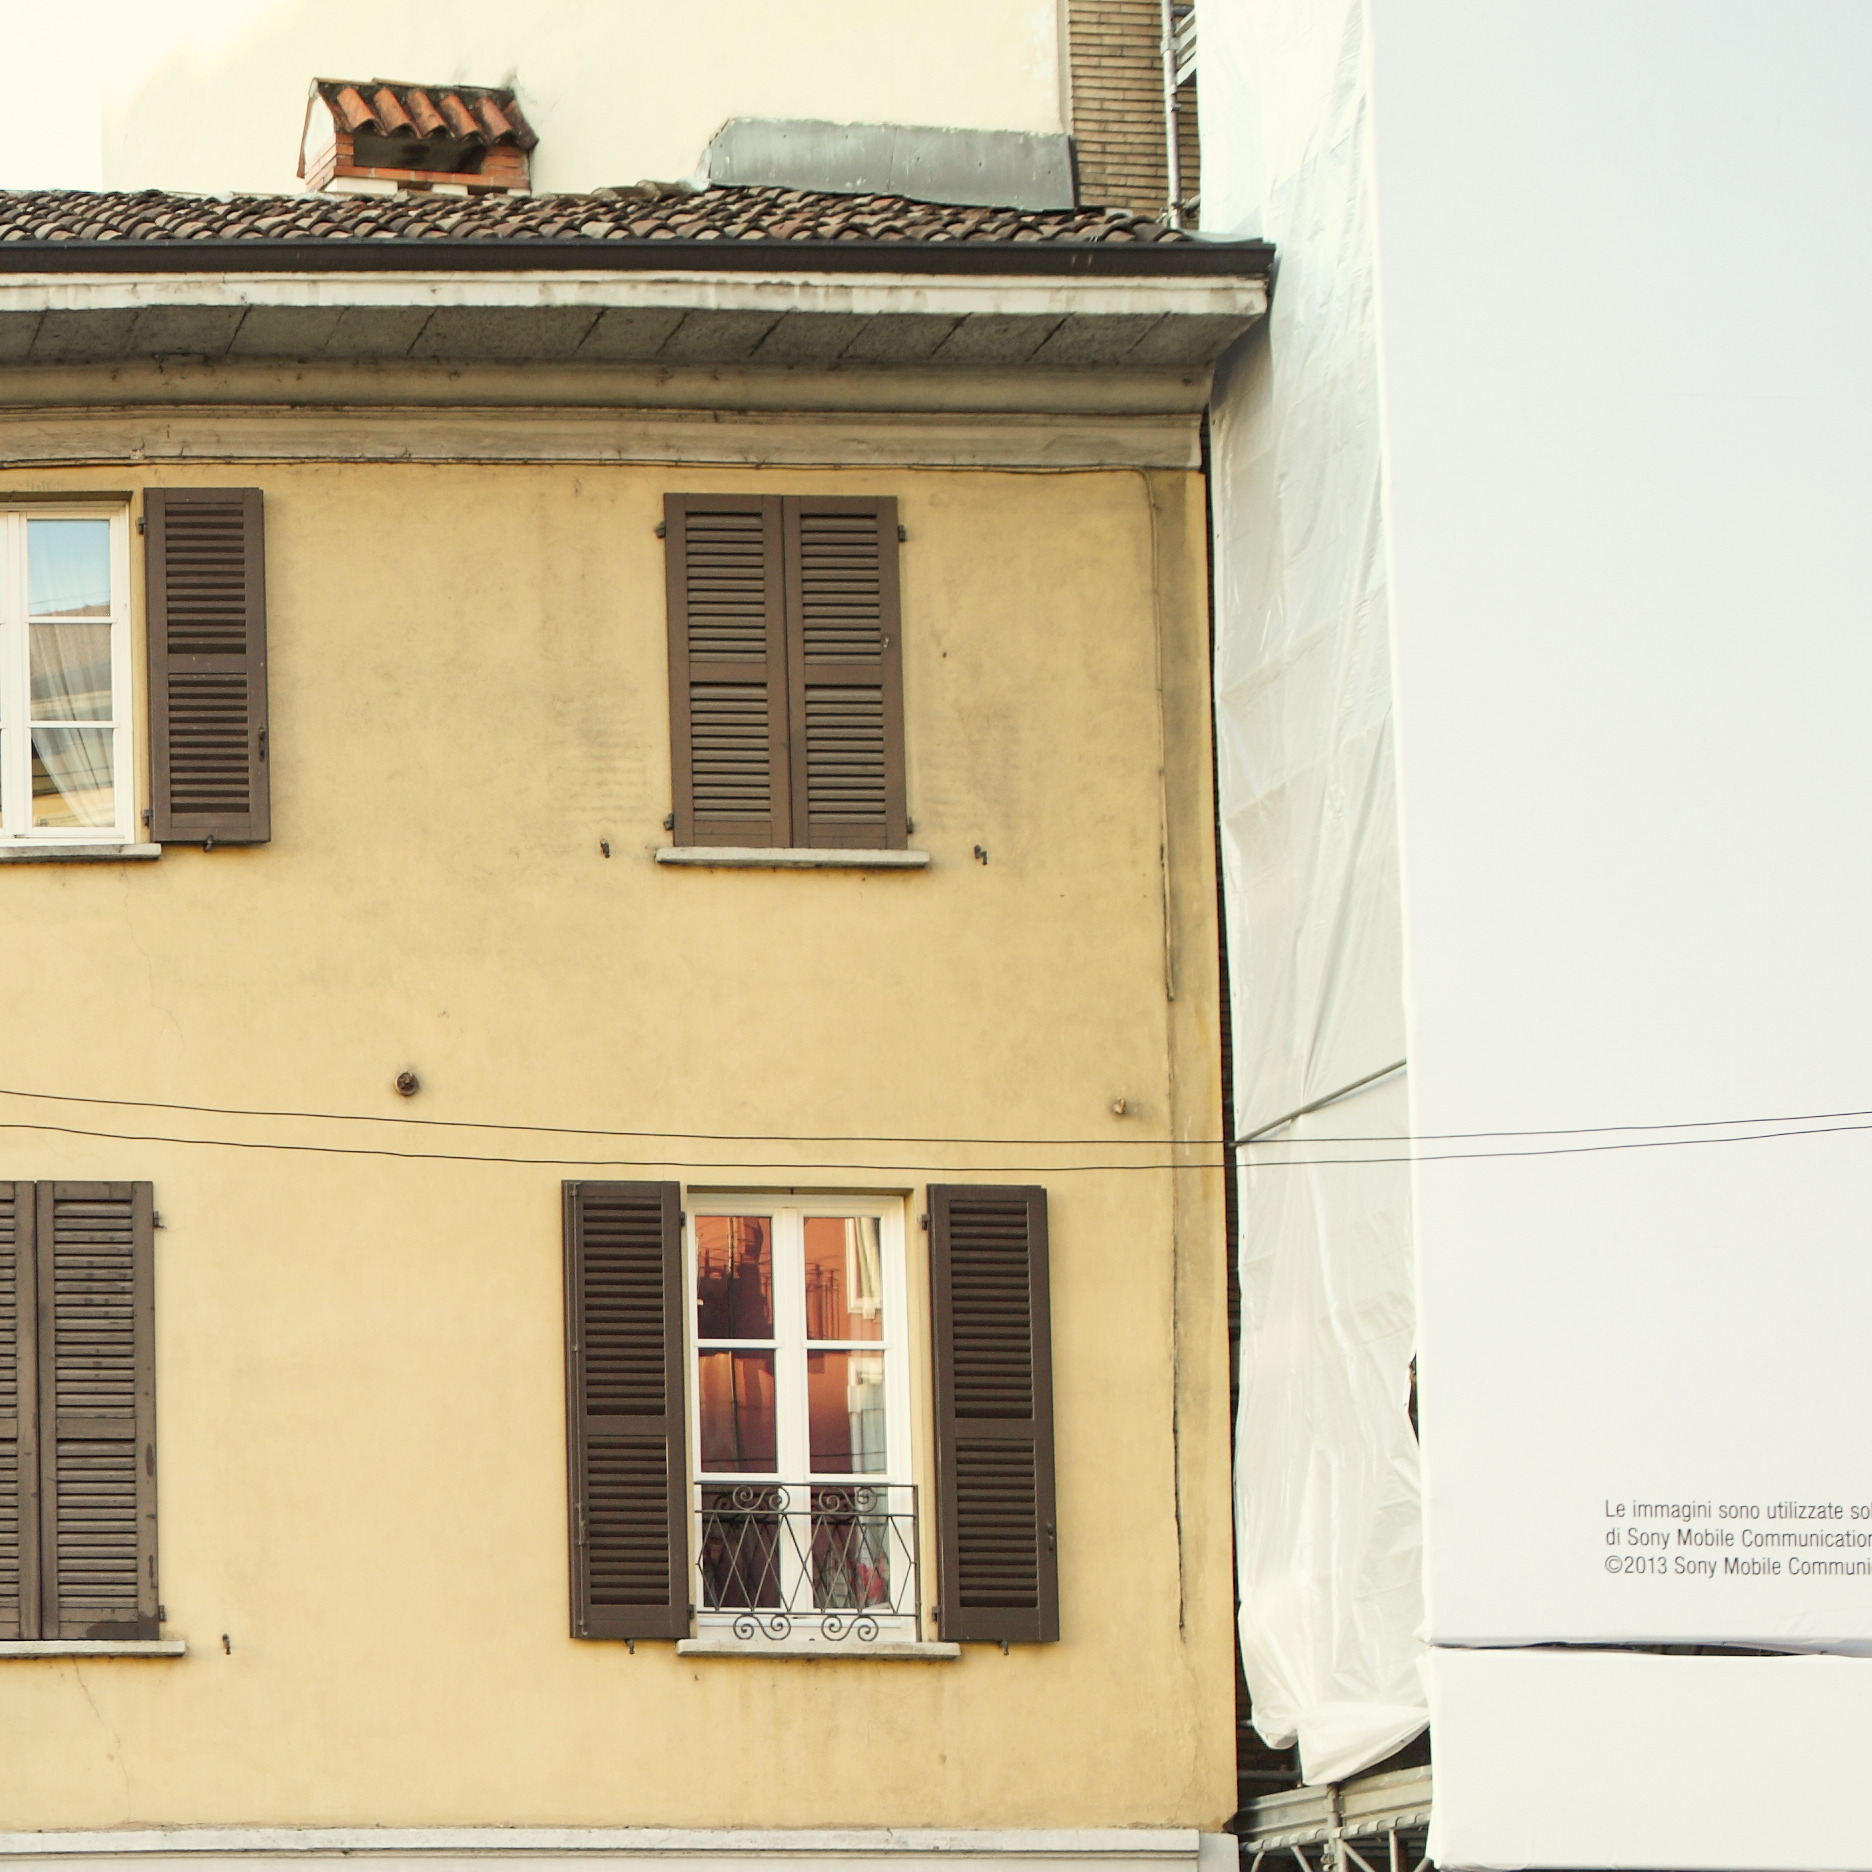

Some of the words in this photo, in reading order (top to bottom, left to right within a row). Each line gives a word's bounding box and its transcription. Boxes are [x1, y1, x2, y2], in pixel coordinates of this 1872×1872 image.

[1605, 1500, 1626, 1518] Le
[1633, 1500, 1712, 1522] immagini
[1719, 1504, 1760, 1519] sono
[1767, 1501, 1843, 1519] utilizzate
[1606, 1528, 1620, 1545] di
[1627, 1528, 1670, 1550] Sony
[1677, 1528, 1734, 1547] Mobile
[1605, 1555, 1667, 1574] ©2013
[1674, 1556, 1717, 1578] Sony
[1724, 1556, 1781, 1575] Mobile
